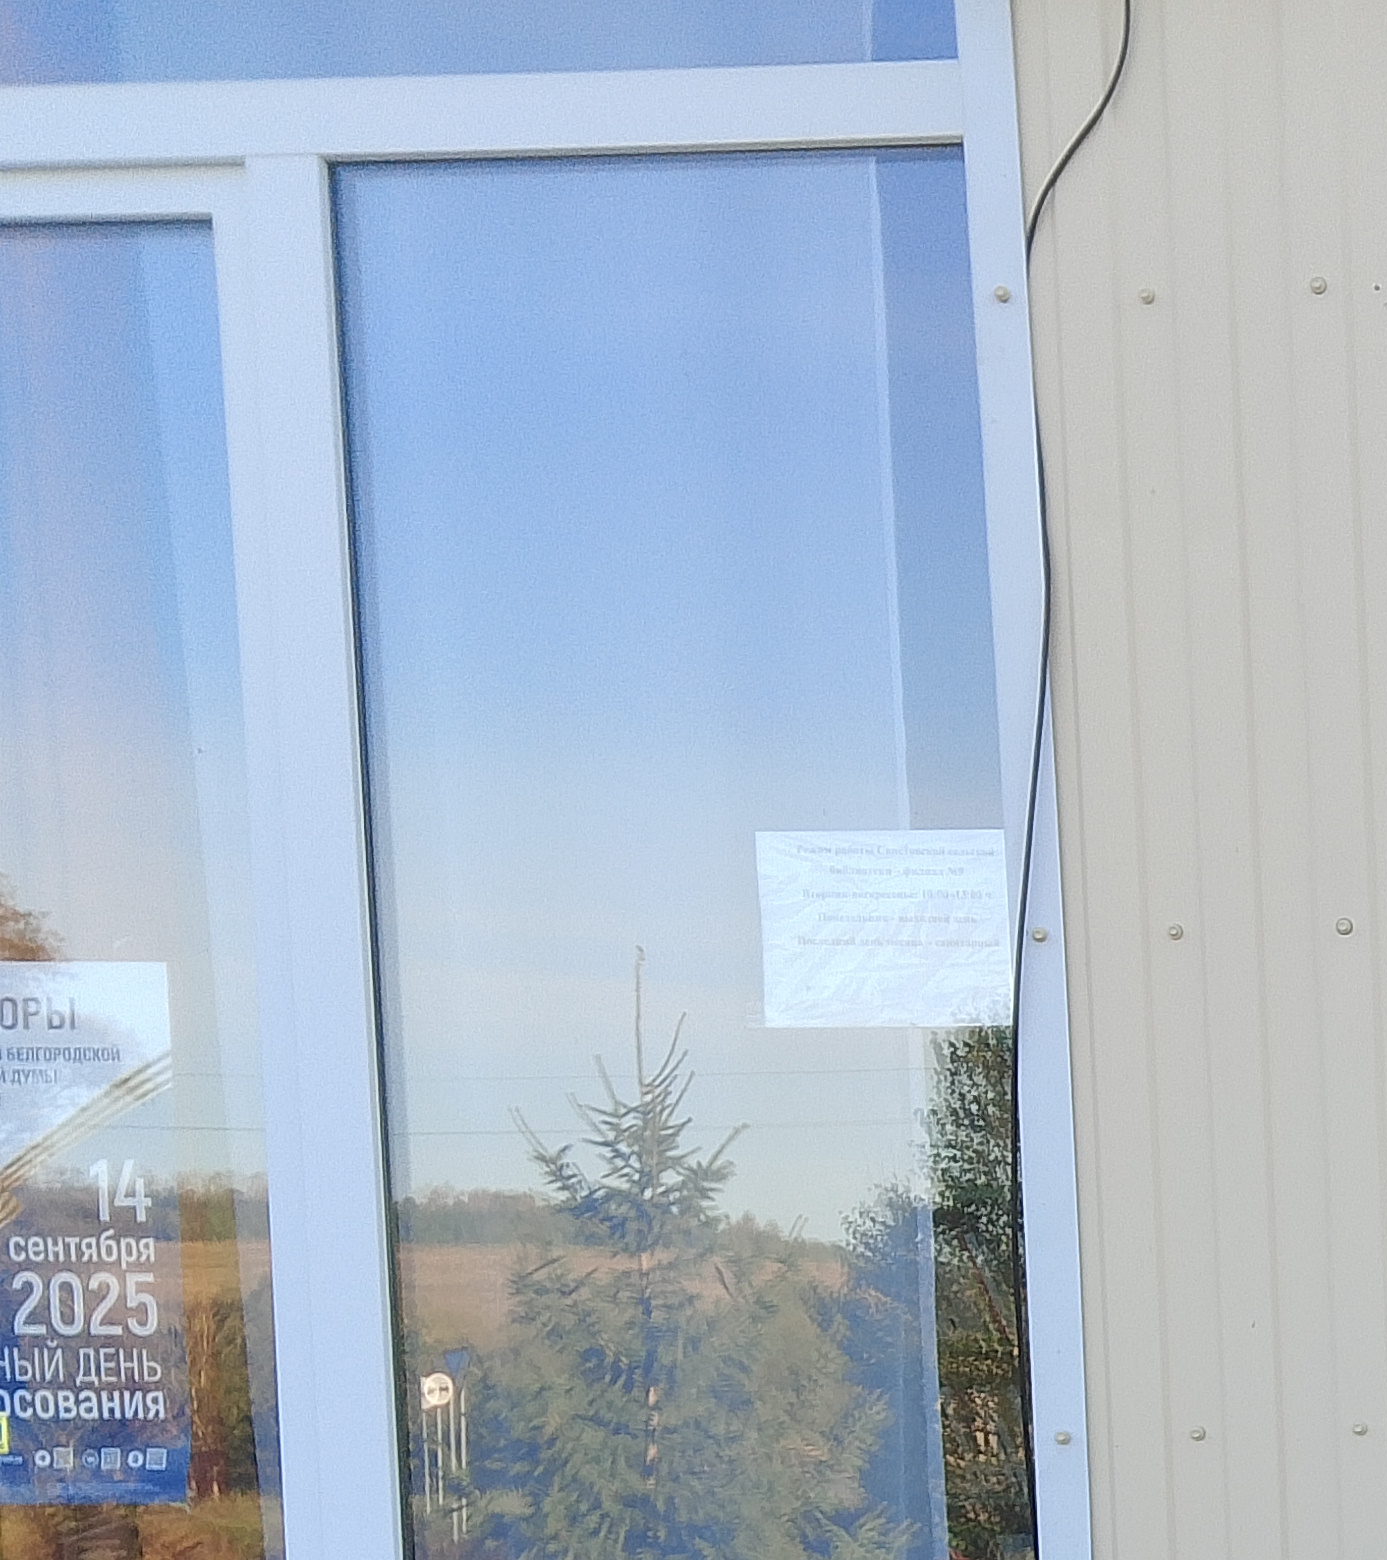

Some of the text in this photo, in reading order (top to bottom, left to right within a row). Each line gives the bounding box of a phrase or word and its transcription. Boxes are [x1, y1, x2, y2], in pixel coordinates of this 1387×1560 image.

[88, 1158, 153, 1223] 14
[8, 1229, 156, 1270] сентября
[12, 1271, 158, 1337] 2025
[75, 1347, 162, 1388] ДЕНЬ
